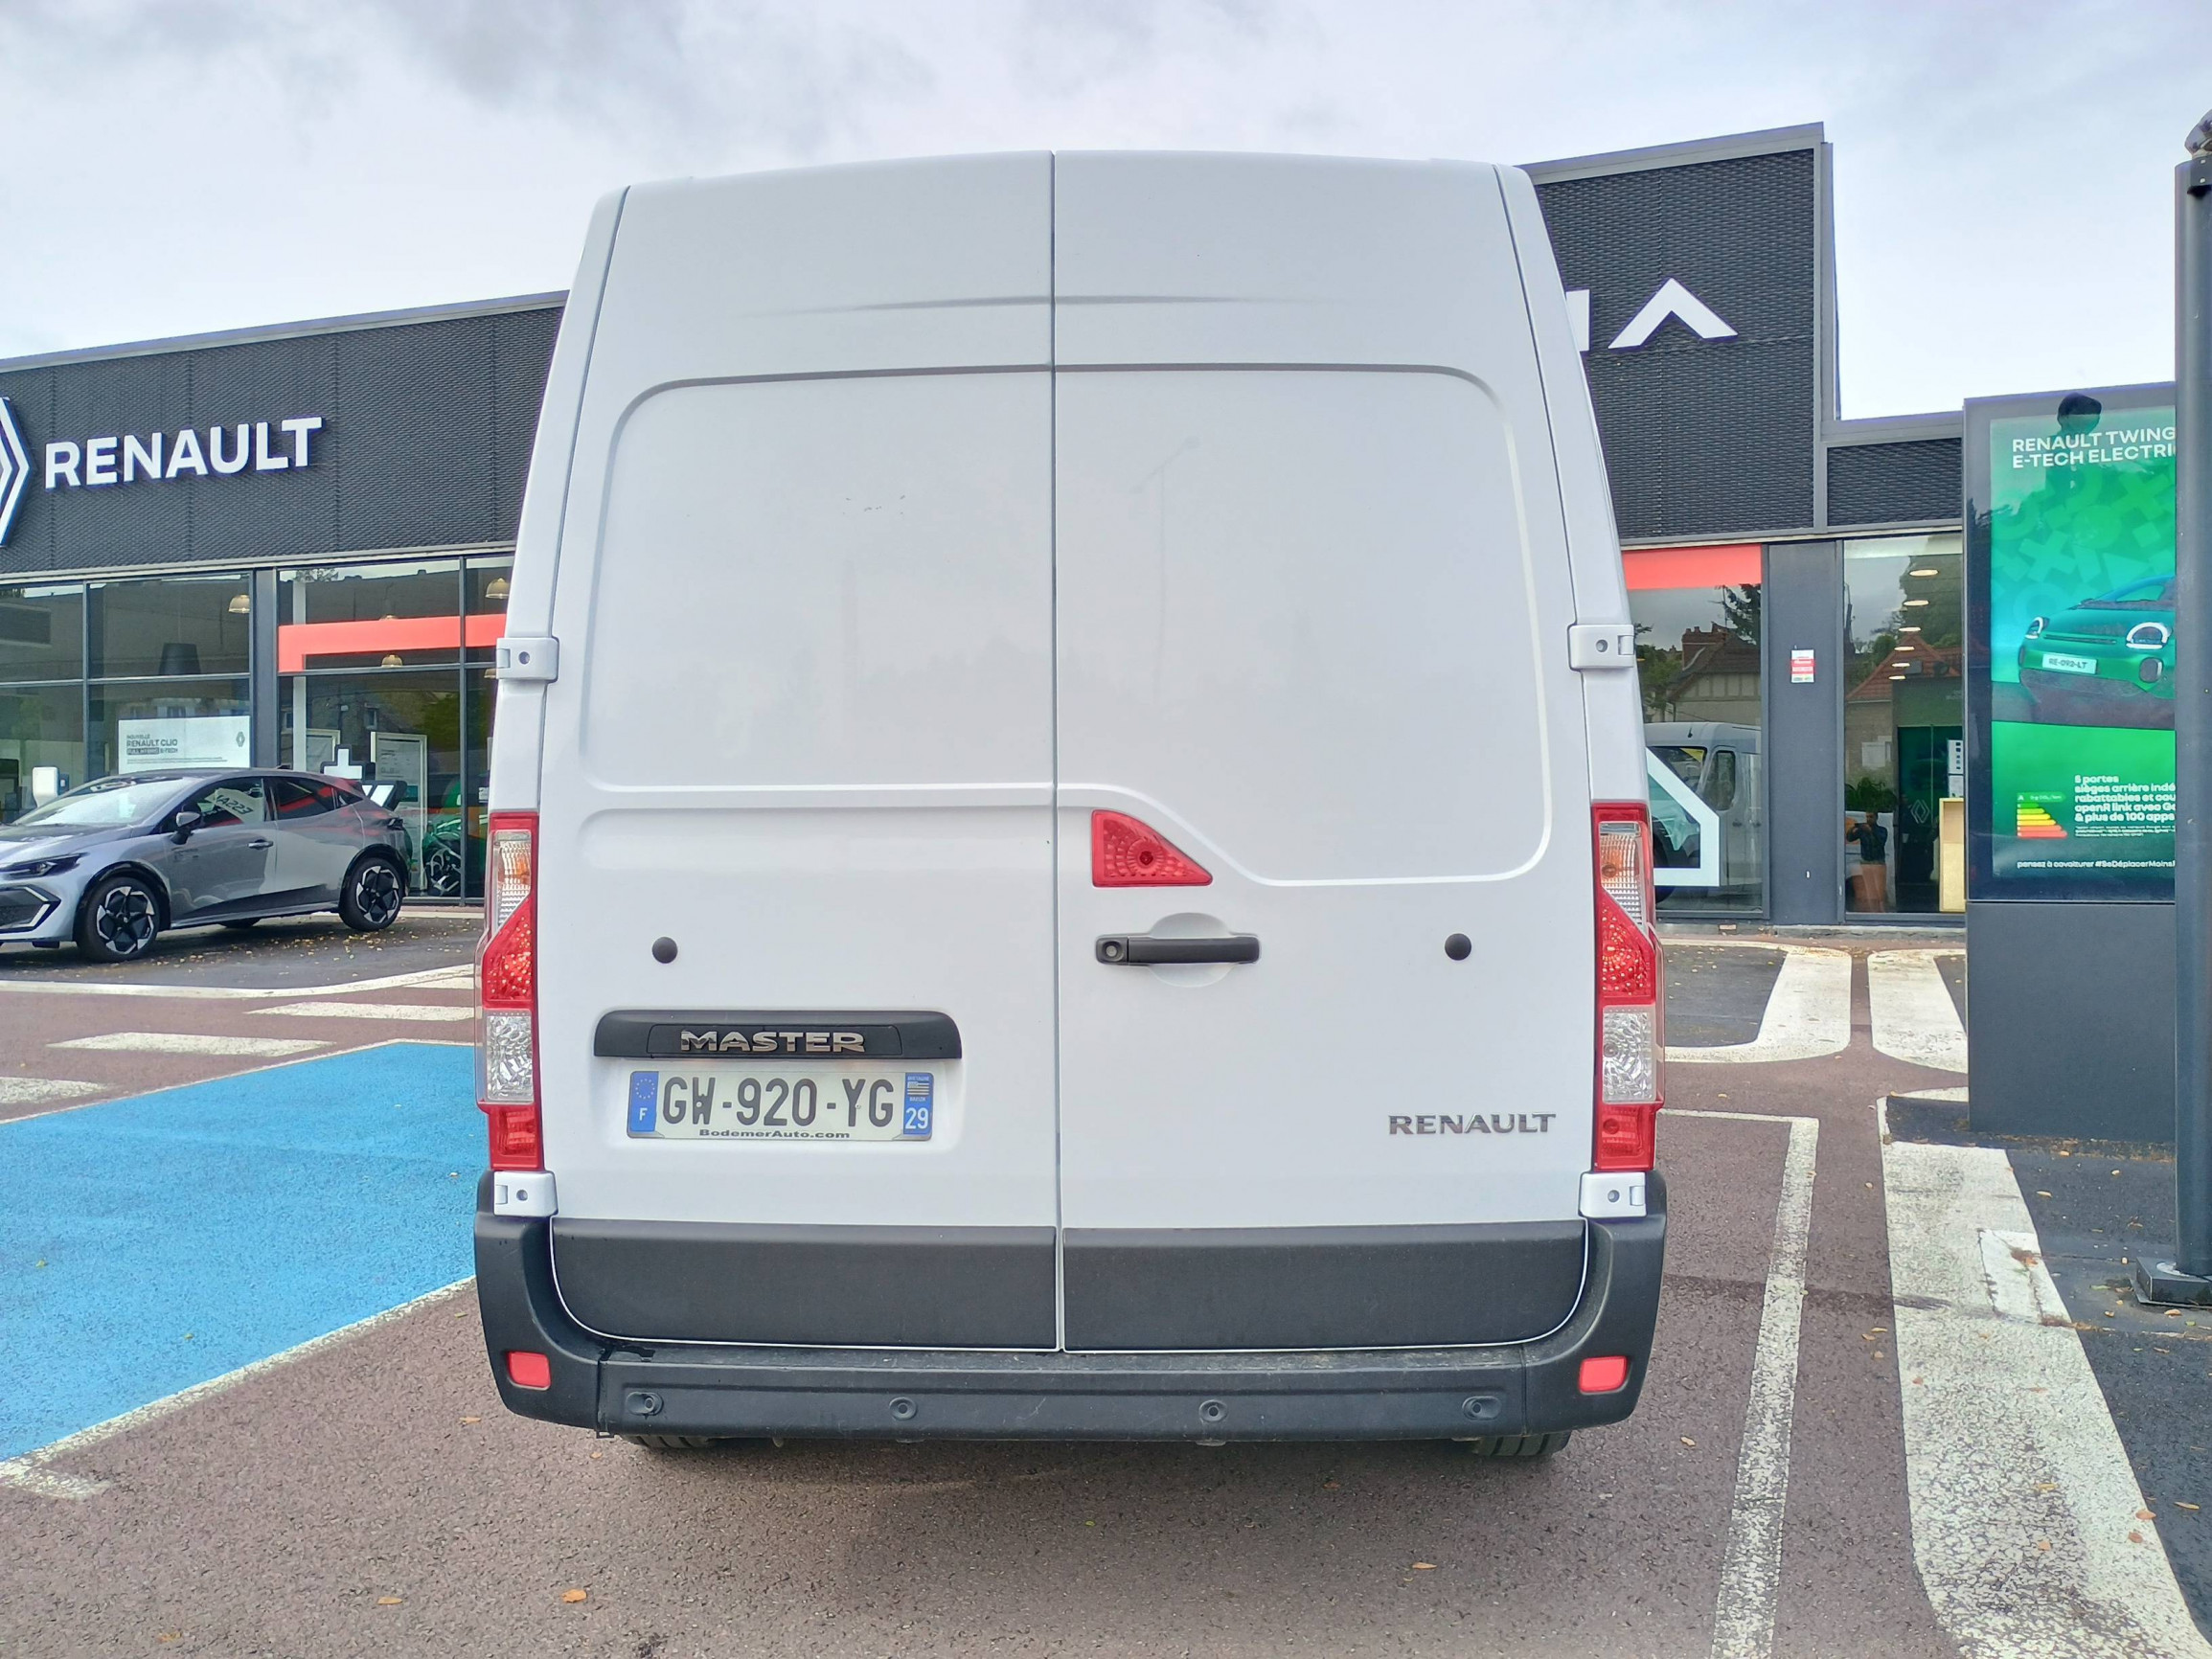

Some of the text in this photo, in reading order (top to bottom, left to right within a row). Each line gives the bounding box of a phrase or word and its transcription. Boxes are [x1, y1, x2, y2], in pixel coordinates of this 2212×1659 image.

[2012, 433, 2102, 453] RENAULT
[45, 416, 323, 490] RENAULT
[2013, 443, 2176, 468] E-TECH ELECTRI
[160, 739, 178, 747] CLIO
[2083, 775, 2119, 785] portes
[2111, 784, 2150, 792] arrière
[2075, 793, 2141, 803] rabattables
[2075, 803, 2110, 813] openR
[2111, 803, 2132, 812] link
[2085, 813, 2109, 824] plus
[2109, 812, 2124, 821] de
[2126, 812, 2145, 821] 100
[2146, 813, 2175, 823] apps
[680, 1031, 866, 1054] MASTER
[662, 1076, 894, 1128] GW-920-YG
[639, 1106, 647, 1122] F
[905, 1106, 929, 1129] 29
[1388, 1112, 1557, 1136] RENAULT
[698, 1128, 850, 1140] BodemerAuto.com
